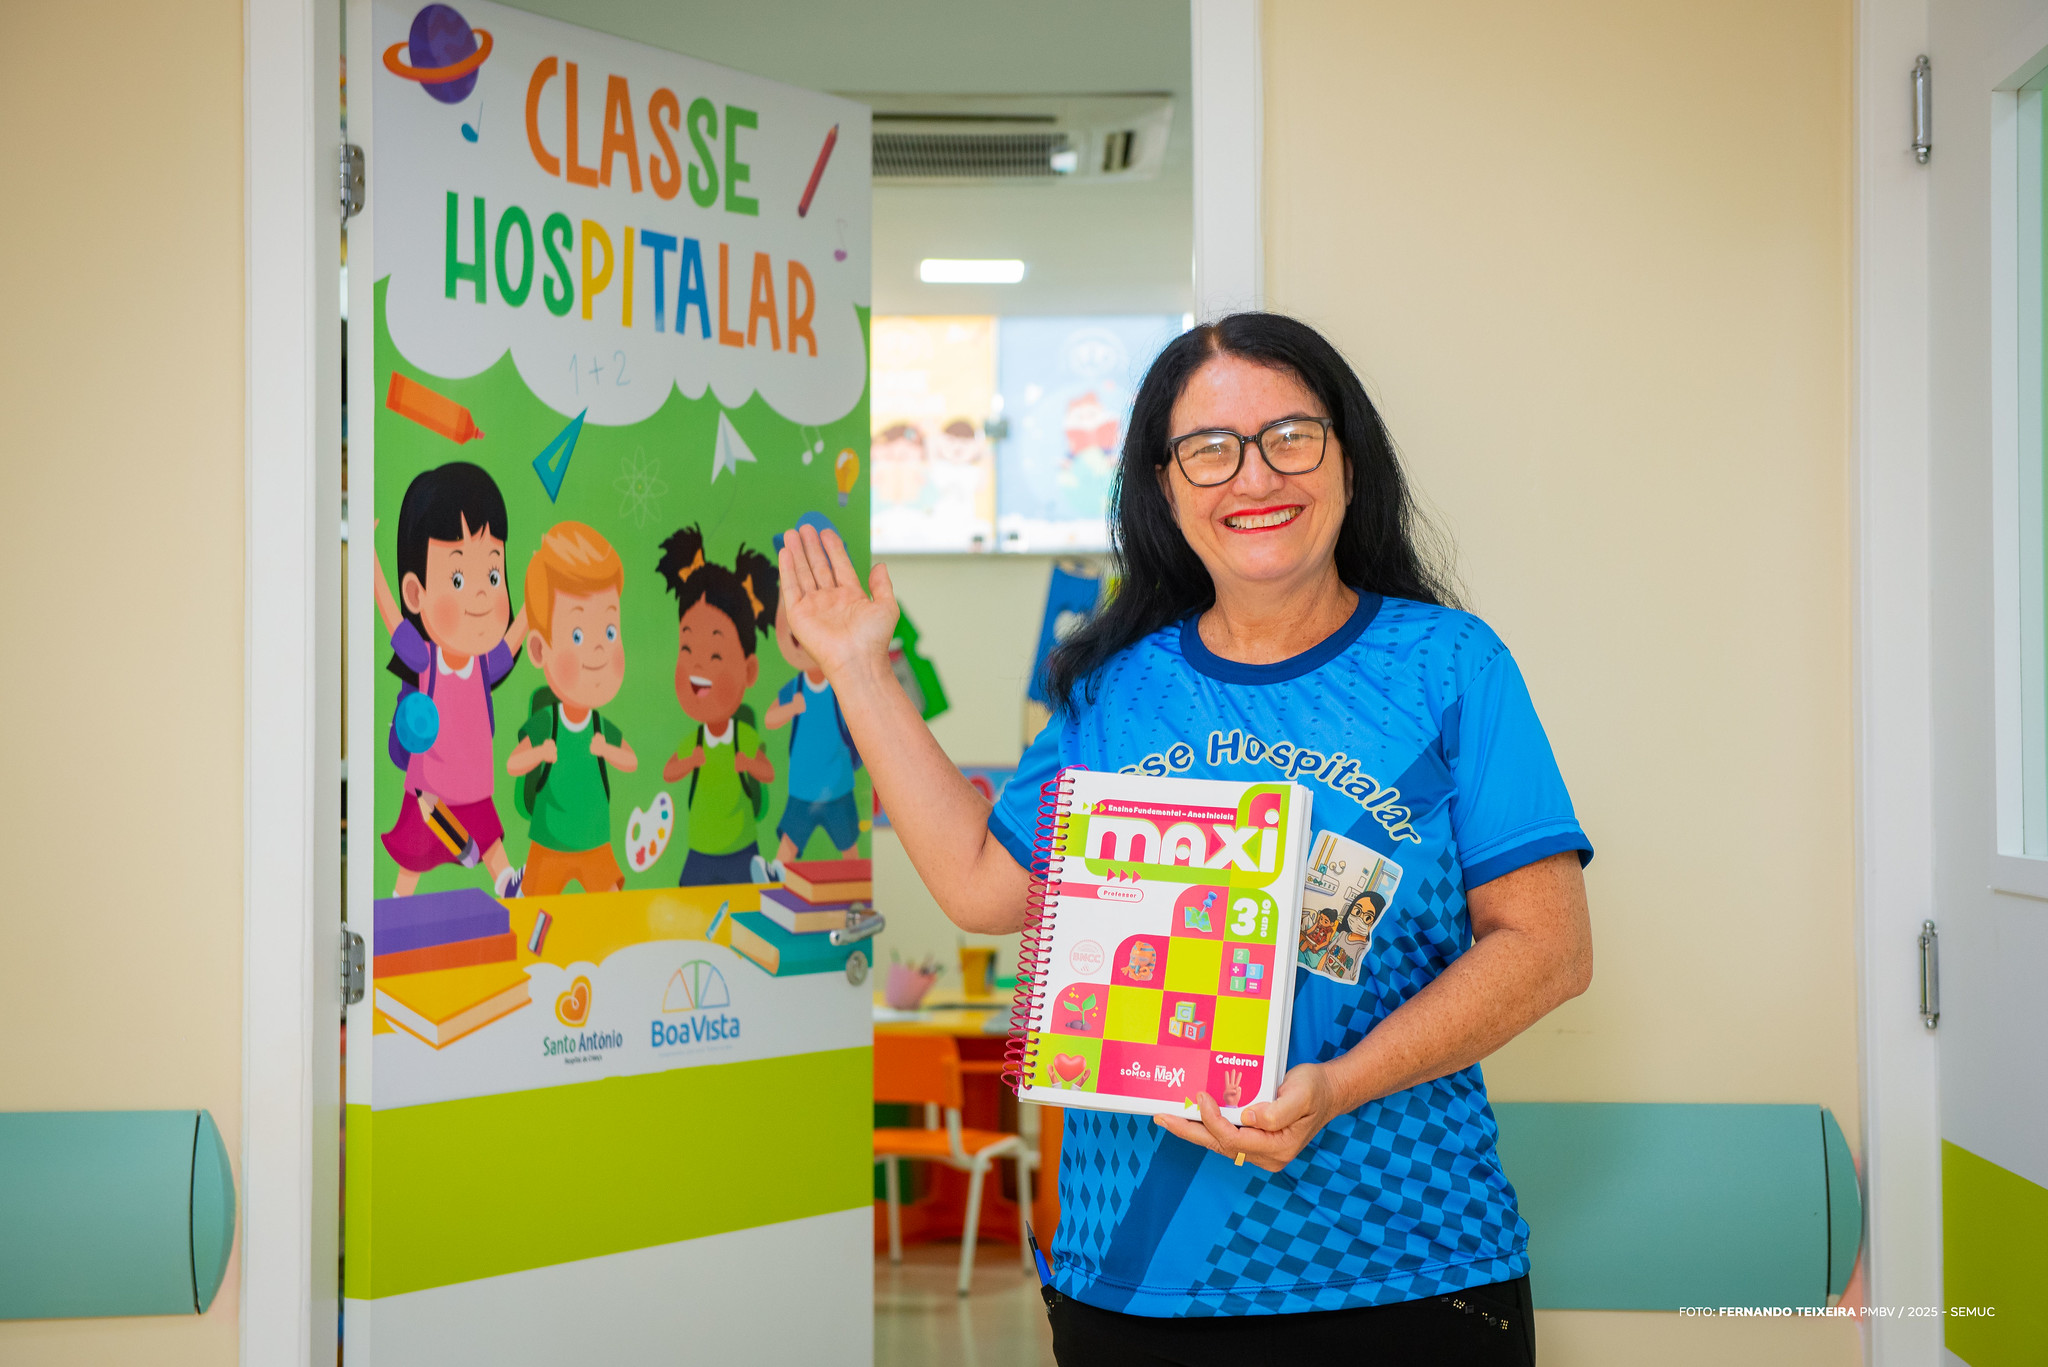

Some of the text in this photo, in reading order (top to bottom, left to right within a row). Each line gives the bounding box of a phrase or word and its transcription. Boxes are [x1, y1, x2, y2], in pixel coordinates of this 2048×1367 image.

[525, 56, 759, 217] CLASSE
[445, 190, 818, 358] HOSPITALAR
[1207, 729, 1421, 844] Hospitalar
[1108, 804, 1133, 813] Ensino
[1134, 806, 1181, 817] Fundamental
[1187, 811, 1206, 819] Anos
[1206, 812, 1234, 821] Iniciais
[1085, 809, 1279, 873] maxi
[1103, 890, 1137, 898] Professor
[543, 1034, 576, 1057] Santo
[1215, 1054, 1258, 1067] Caderno
